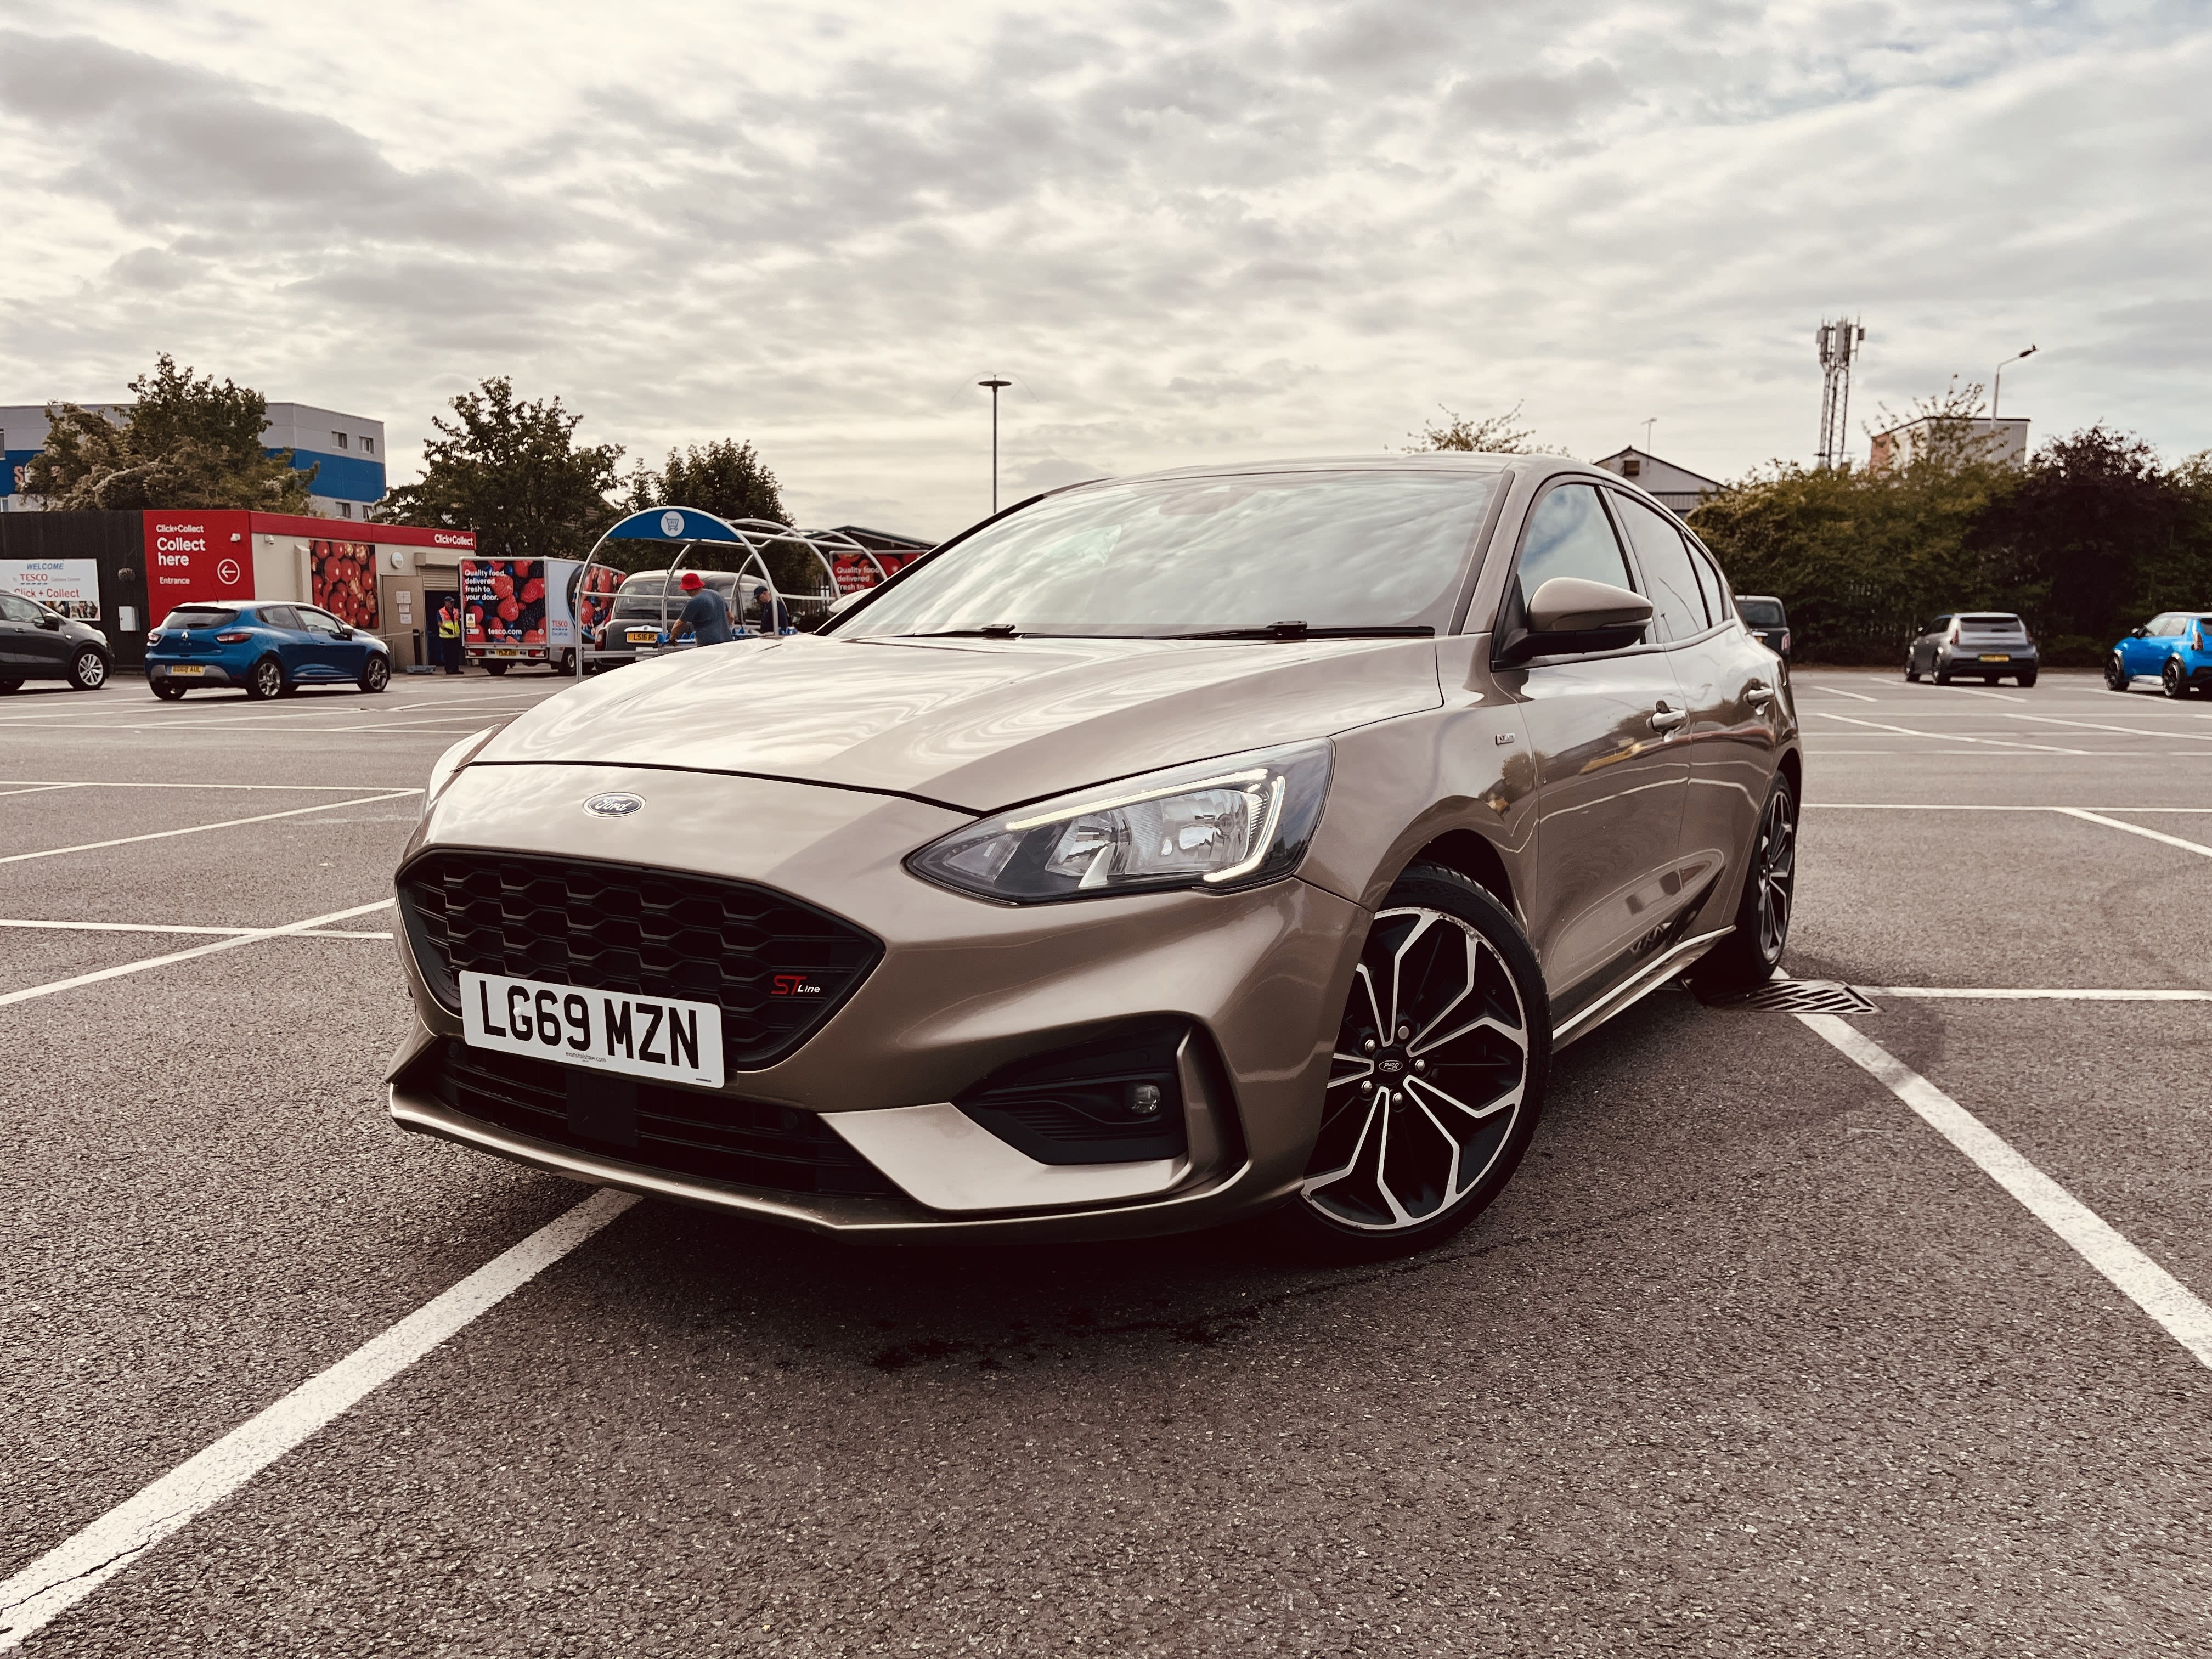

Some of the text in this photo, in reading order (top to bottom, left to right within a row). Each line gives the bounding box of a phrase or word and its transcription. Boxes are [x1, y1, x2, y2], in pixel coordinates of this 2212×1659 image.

[156, 524, 205, 533] Click+Collect
[157, 537, 206, 551] Collect
[435, 533, 473, 546] Click+Collect
[157, 552, 189, 566] here
[464, 569, 488, 578] Quality
[837, 566, 862, 576] Quality
[47, 588, 80, 598] Collect
[595, 797, 633, 811] Ford
[771, 974, 820, 995] ST Line
[479, 979, 699, 1070] LG69 MZN
